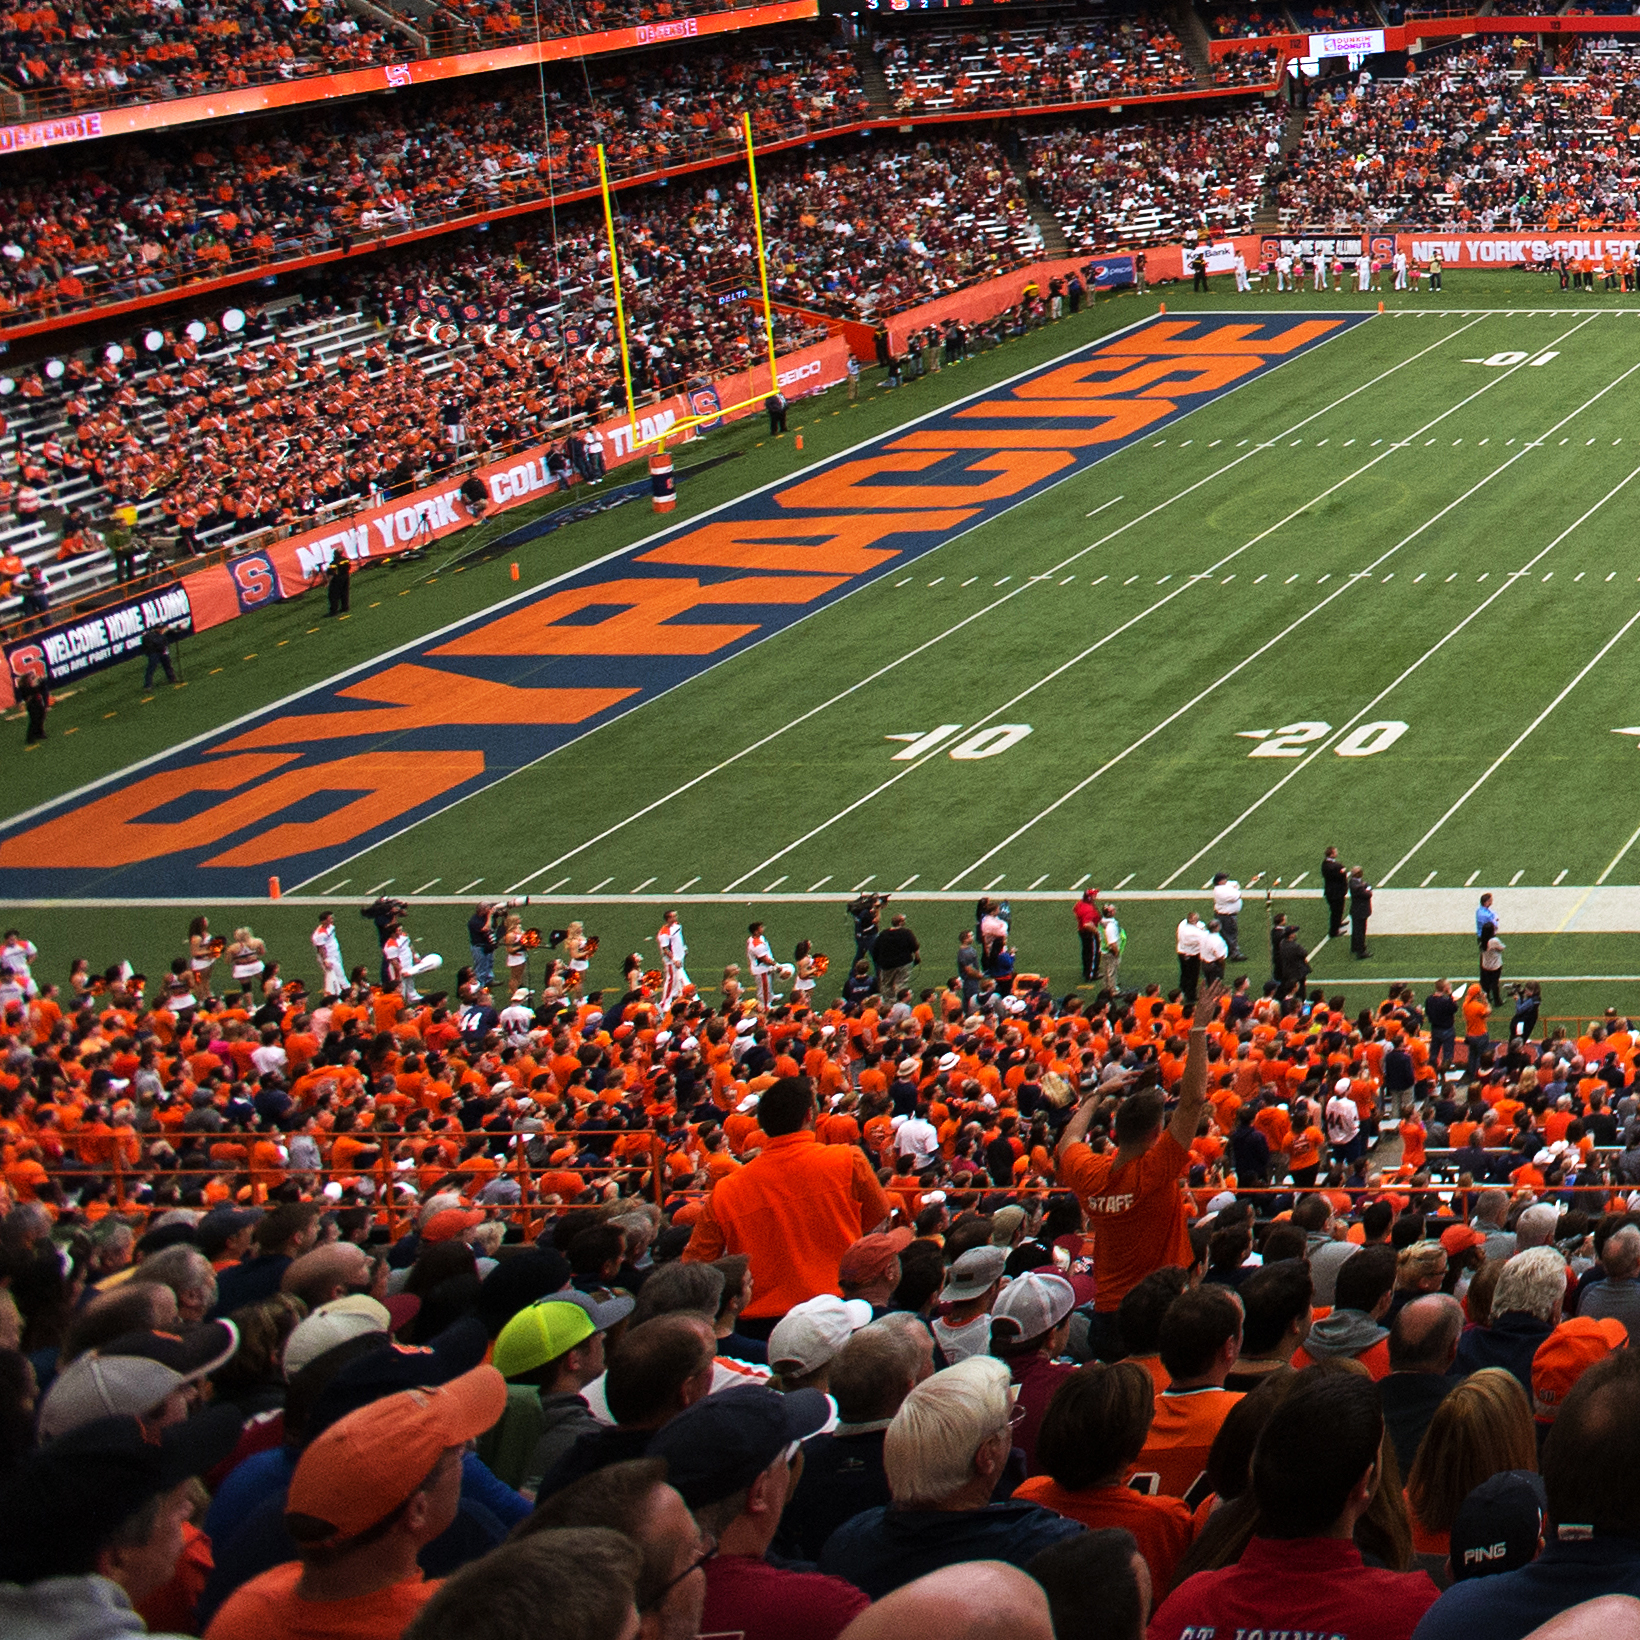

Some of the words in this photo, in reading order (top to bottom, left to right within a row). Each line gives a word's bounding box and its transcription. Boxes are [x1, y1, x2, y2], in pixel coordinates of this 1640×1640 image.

[920, 0, 930, 8] 2
[1337, 42, 1372, 51] DONUTS
[1412, 241, 1461, 261] NEW
[1466, 241, 1554, 261] YORK'S
[718, 290, 748, 305] DELTA
[776, 360, 822, 388] GEICO
[298, 522, 371, 579] NEW
[374, 487, 468, 547] YORK'
[0, 317, 1351, 870] SYRACUSE
[234, 556, 274, 604] S
[42, 618, 109, 665] WELCOME
[104, 606, 144, 642] HOME
[141, 588, 190, 626] ALUMNI
[50, 664, 70, 679] YOU
[71, 657, 89, 671] ARE
[88, 648, 111, 666] PART
[111, 644, 124, 656] OF
[893, 723, 1036, 760] 10
[1246, 719, 1410, 757] 20
[1087, 1193, 1134, 1213] STAFF
[1464, 1541, 1507, 1566] PING
